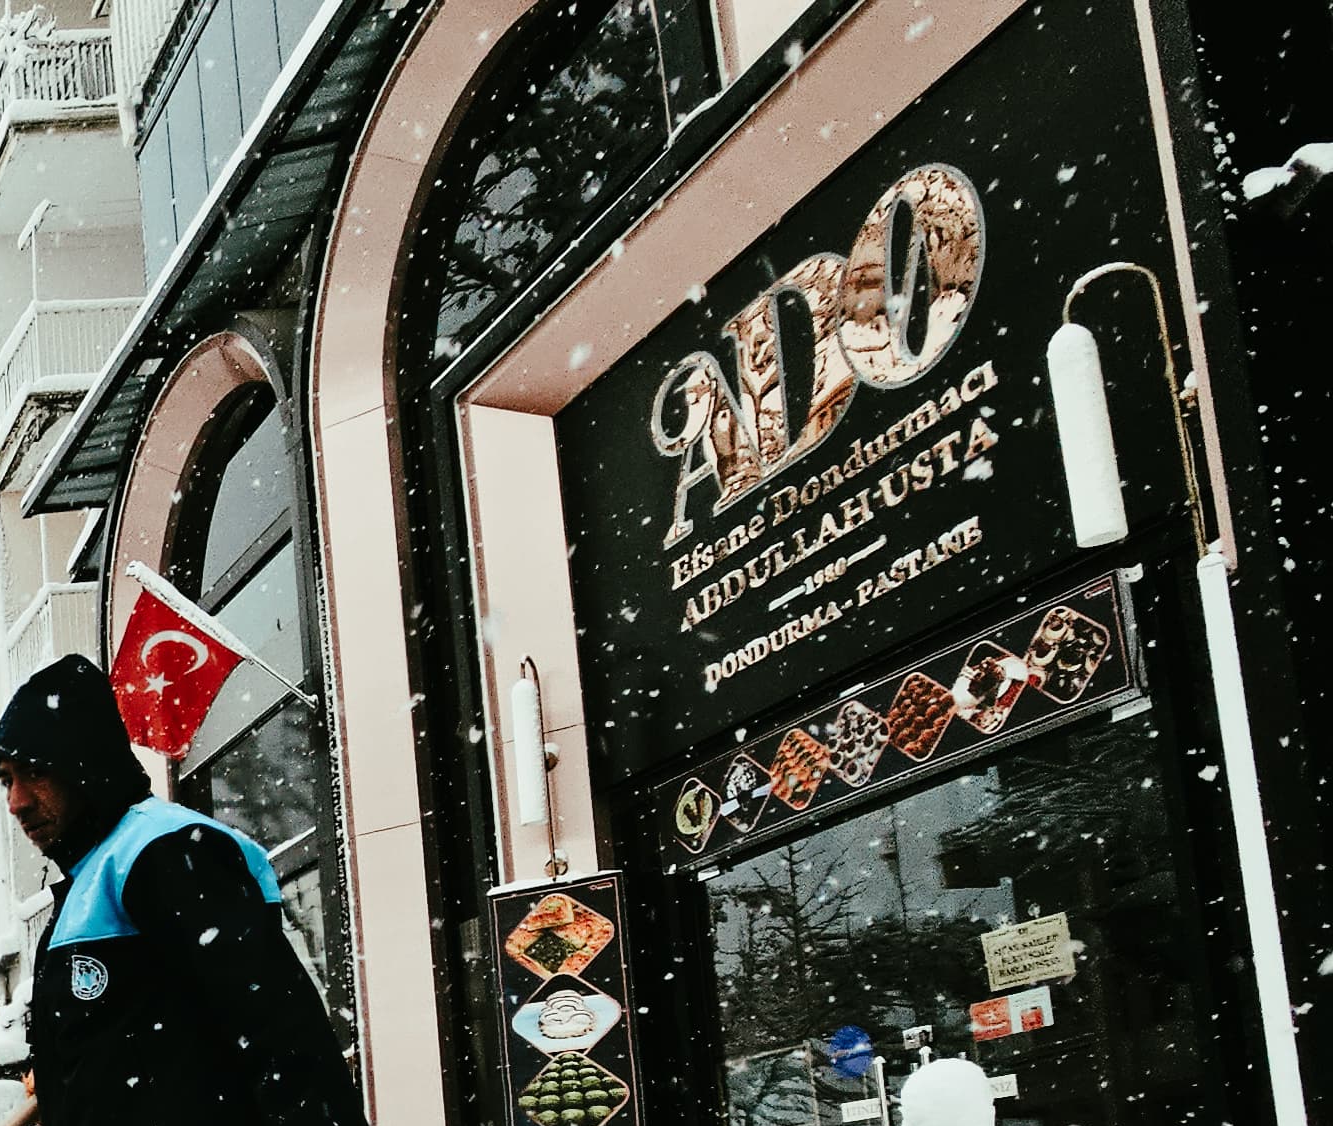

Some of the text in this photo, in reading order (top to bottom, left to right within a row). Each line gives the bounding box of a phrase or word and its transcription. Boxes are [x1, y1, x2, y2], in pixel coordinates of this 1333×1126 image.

[650, 162, 986, 550] ADO
[670, 512, 766, 591] Efsane
[681, 416, 999, 632] ABDULLAH USTA
[704, 601, 842, 686] DONDURMA
[856, 515, 983, 608] PASTANE
